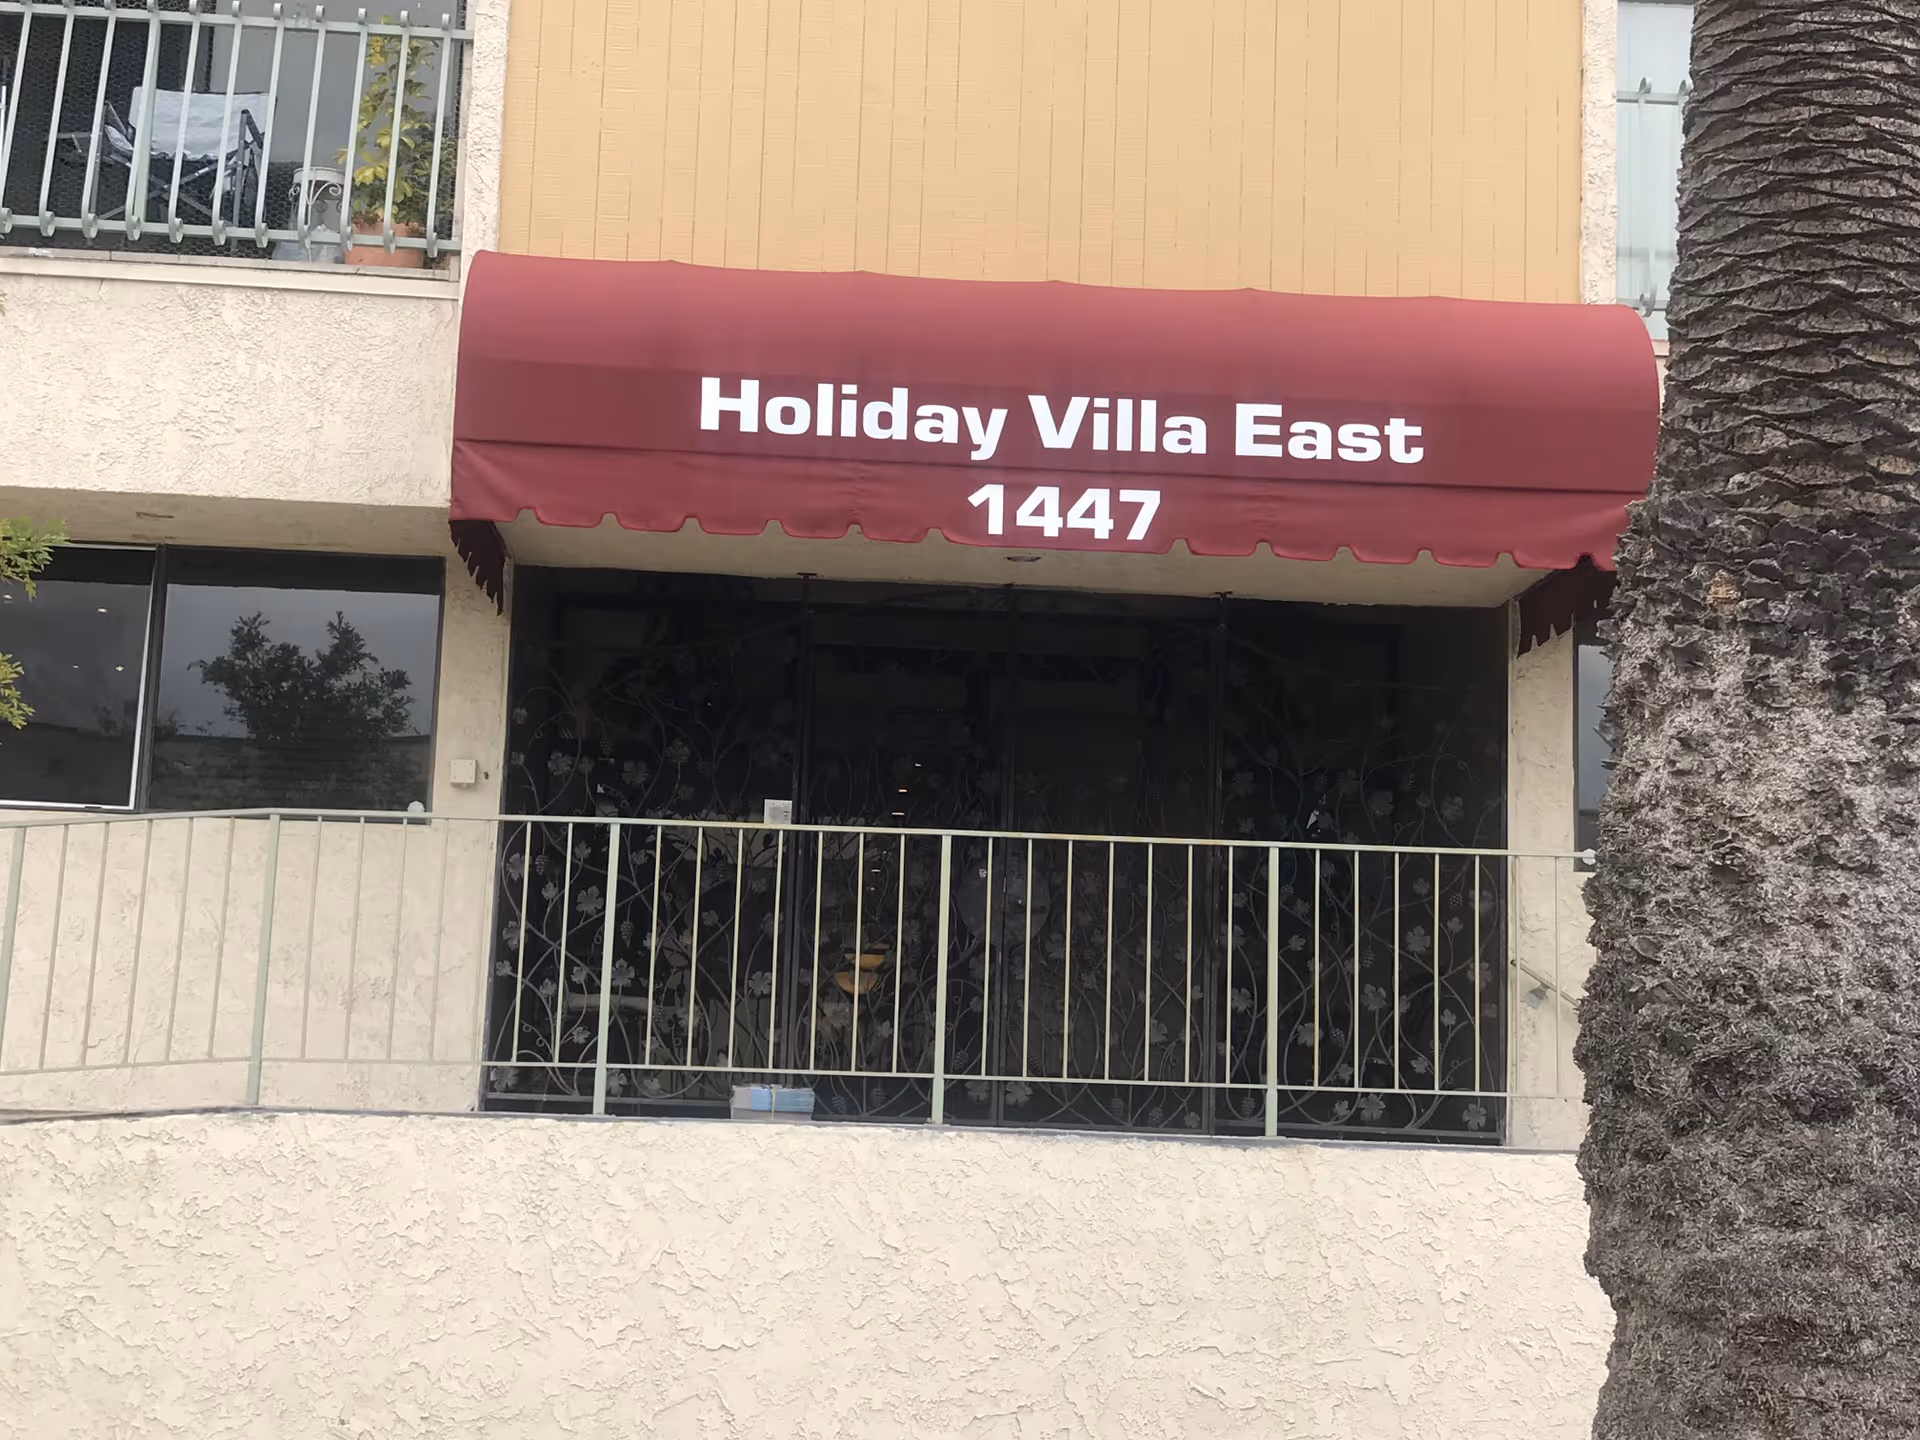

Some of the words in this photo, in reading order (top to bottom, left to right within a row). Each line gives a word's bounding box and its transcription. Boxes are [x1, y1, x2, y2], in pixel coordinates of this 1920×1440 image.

[700, 376, 1008, 461] Holiday
[1028, 394, 1207, 455] Villa
[1235, 402, 1424, 464] East
[967, 483, 1161, 541] 1447
